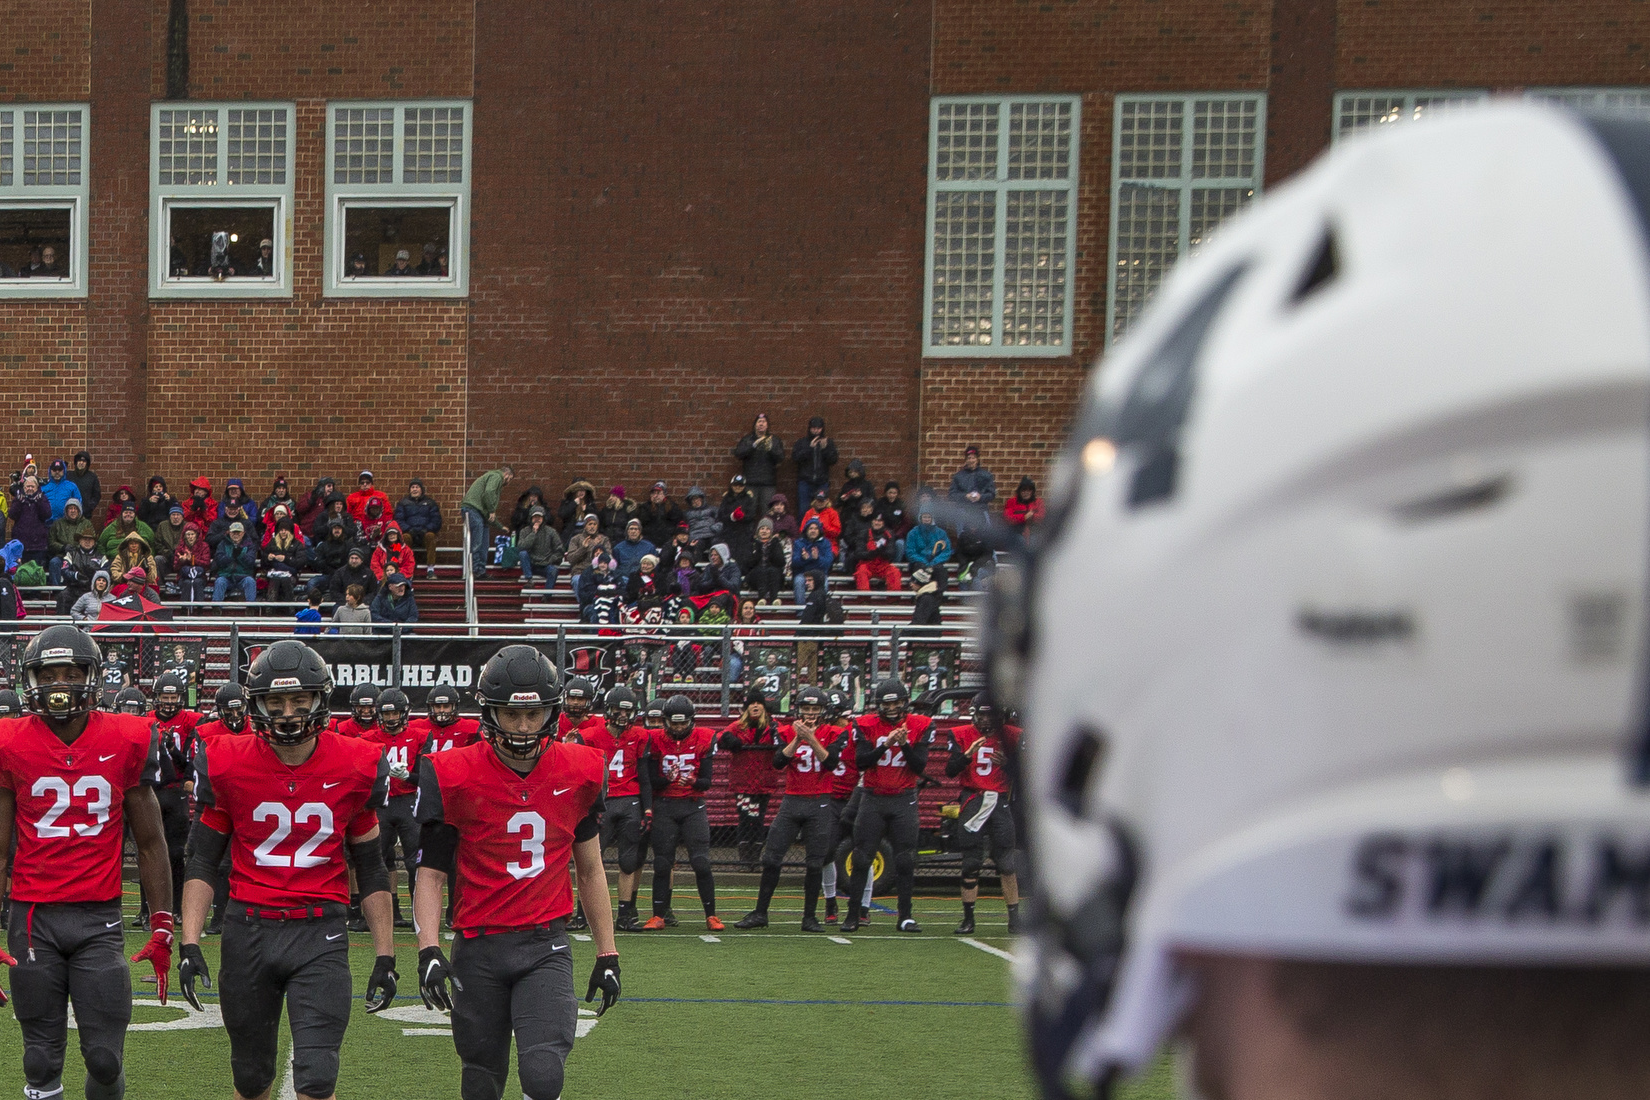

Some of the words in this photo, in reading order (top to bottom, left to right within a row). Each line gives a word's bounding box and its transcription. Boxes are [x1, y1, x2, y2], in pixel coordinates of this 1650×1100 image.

[637, 671, 645, 685] 3
[840, 676, 849, 691] 4
[513, 693, 537, 701] Riddell
[609, 749, 624, 778] 4
[976, 746, 994, 776] 5
[31, 775, 111, 838] 23
[252, 801, 334, 868] 22
[506, 811, 546, 880] 3
